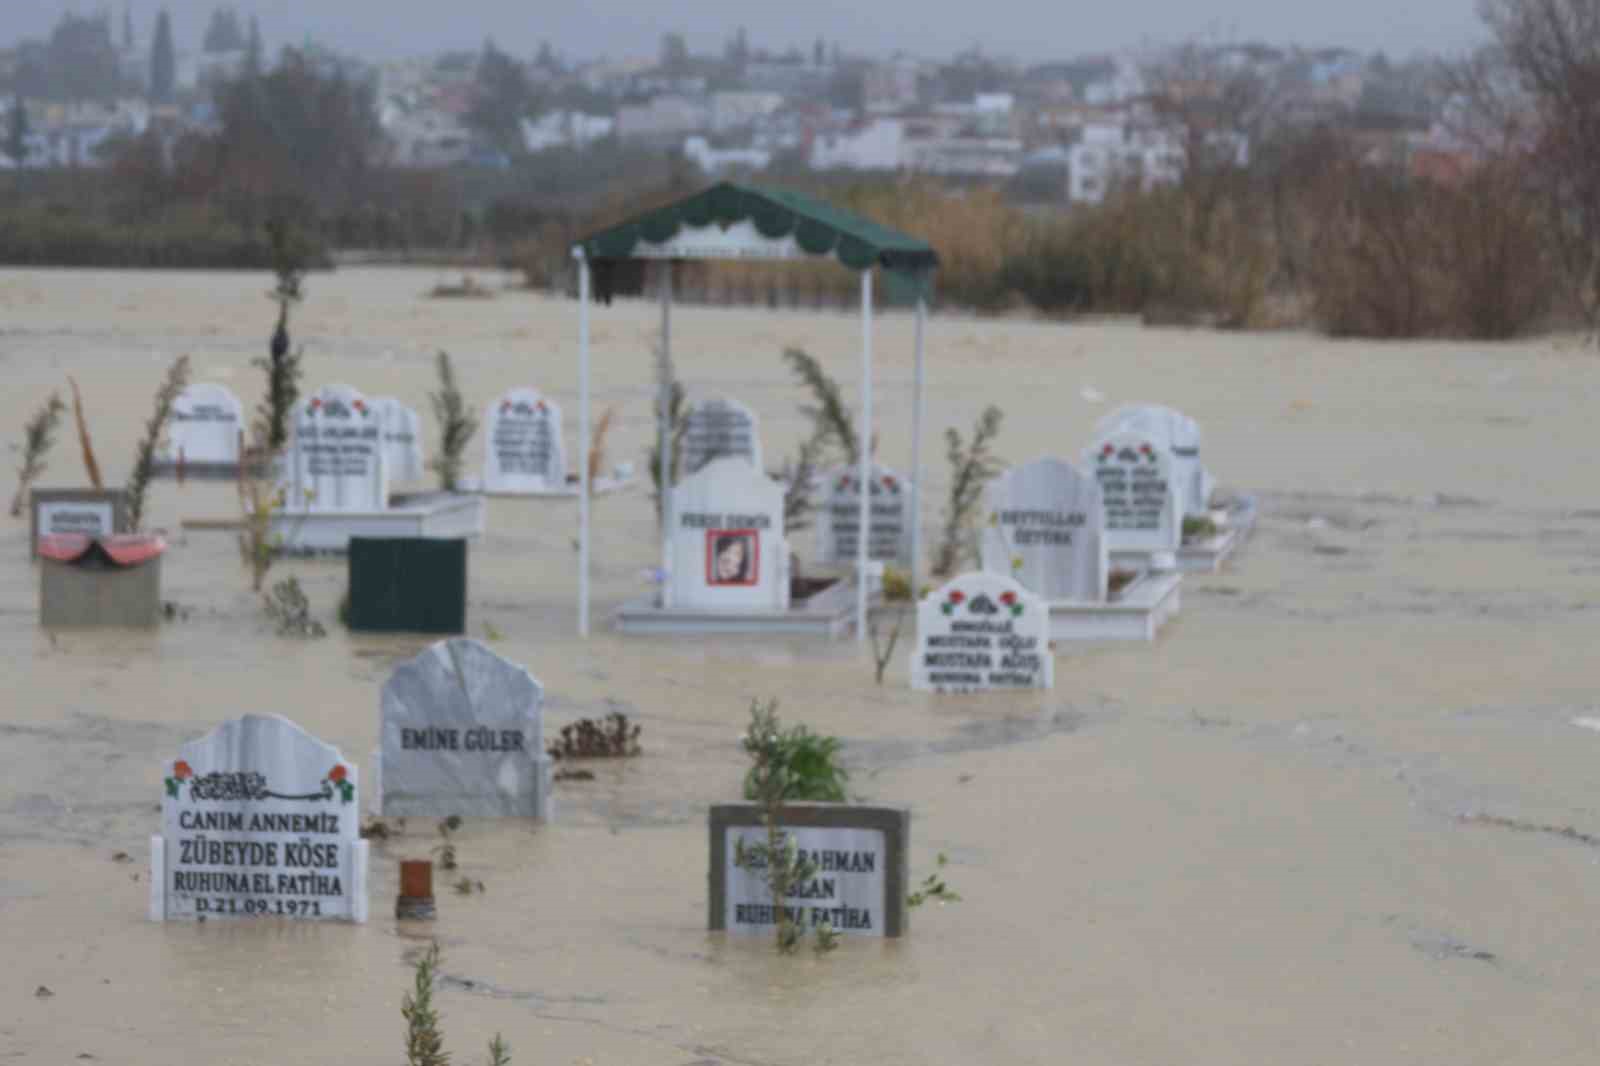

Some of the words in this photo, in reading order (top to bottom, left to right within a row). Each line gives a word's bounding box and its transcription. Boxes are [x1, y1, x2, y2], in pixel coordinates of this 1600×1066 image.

[401, 725, 458, 751] EMİNE
[464, 725, 525, 752] GÜLER
[180, 810, 243, 832] CANIM
[249, 811, 339, 834] ANNEMİZ
[180, 836, 278, 866] ZÜBEYDE
[284, 838, 338, 868] KÖSE
[174, 871, 249, 893] RUHUNA
[253, 874, 275, 893] EL
[277, 871, 343, 896] FATİHA
